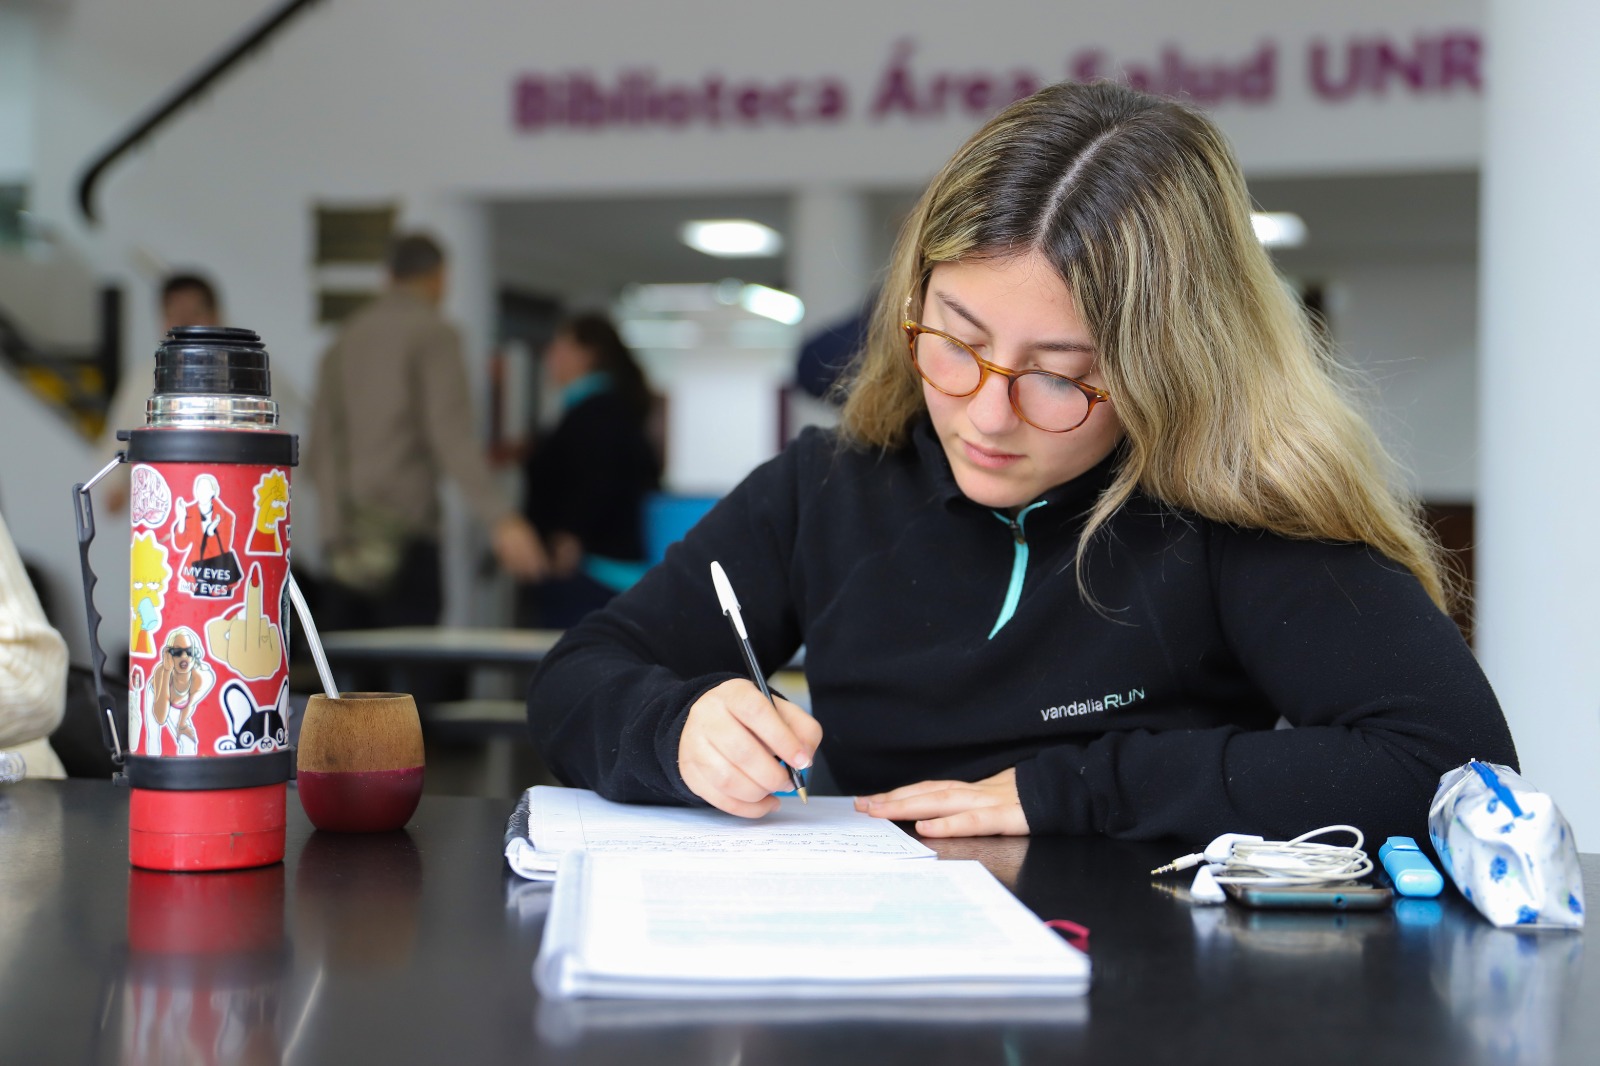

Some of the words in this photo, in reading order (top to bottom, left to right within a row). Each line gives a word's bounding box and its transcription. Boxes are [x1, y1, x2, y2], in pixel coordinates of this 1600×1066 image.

[512, 71, 847, 130] Biblioteca
[1309, 30, 1482, 101] UNR
[183, 566, 202, 577] MY
[203, 568, 231, 580] EYES
[200, 583, 228, 595] EYES
